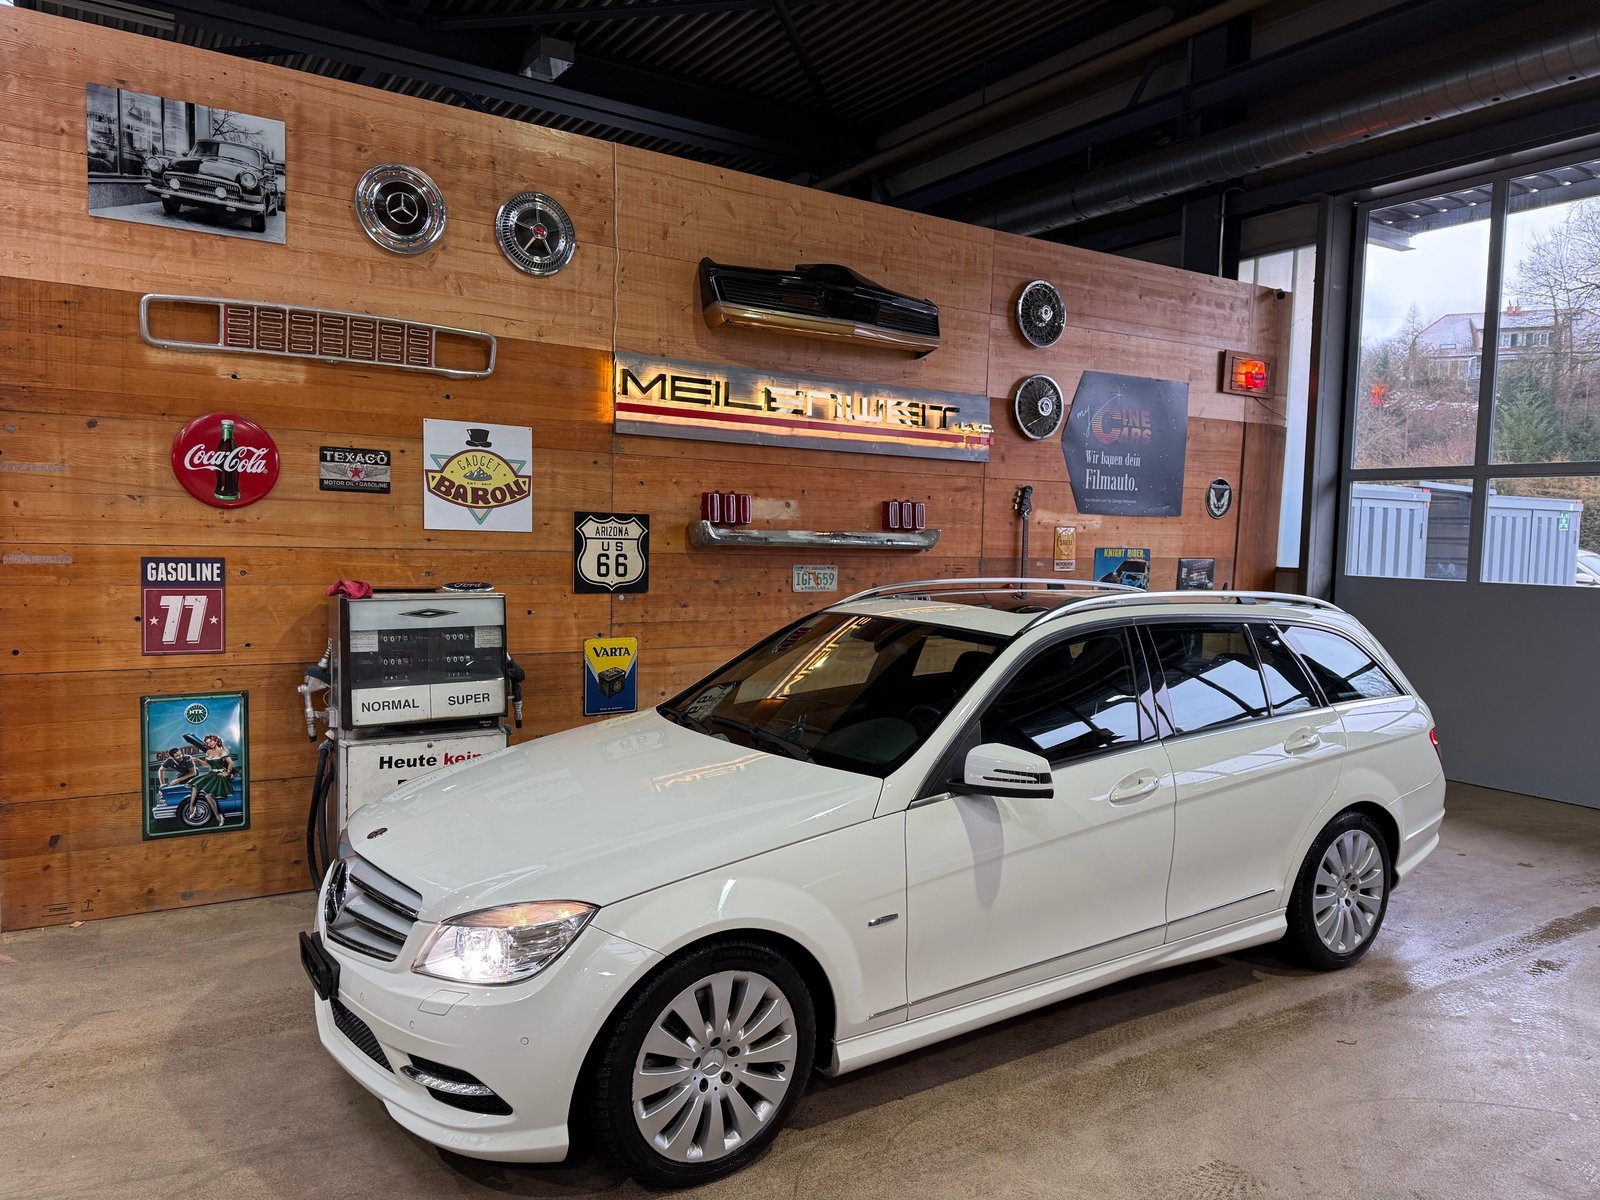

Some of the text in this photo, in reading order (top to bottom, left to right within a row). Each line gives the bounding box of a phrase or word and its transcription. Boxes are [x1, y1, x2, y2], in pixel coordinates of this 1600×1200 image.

[184, 443, 268, 474] Coca-Cola
[323, 450, 388, 465] TEXACO
[456, 454, 502, 473] GADGET
[1085, 450, 1141, 468] Wir bauen dein
[323, 479, 344, 487] MOTOR
[431, 474, 528, 505] BARON
[1085, 468, 1139, 492] Filmauto.
[594, 525, 630, 537] ARIZONA
[1104, 549, 1125, 558] KNIGHT
[146, 562, 221, 582] GASOLINE
[596, 553, 628, 578] 66
[159, 595, 209, 645] 77
[592, 646, 631, 658] VARTA
[361, 692, 491, 713] NORMAL SUPER
[379, 754, 438, 770] Heute
